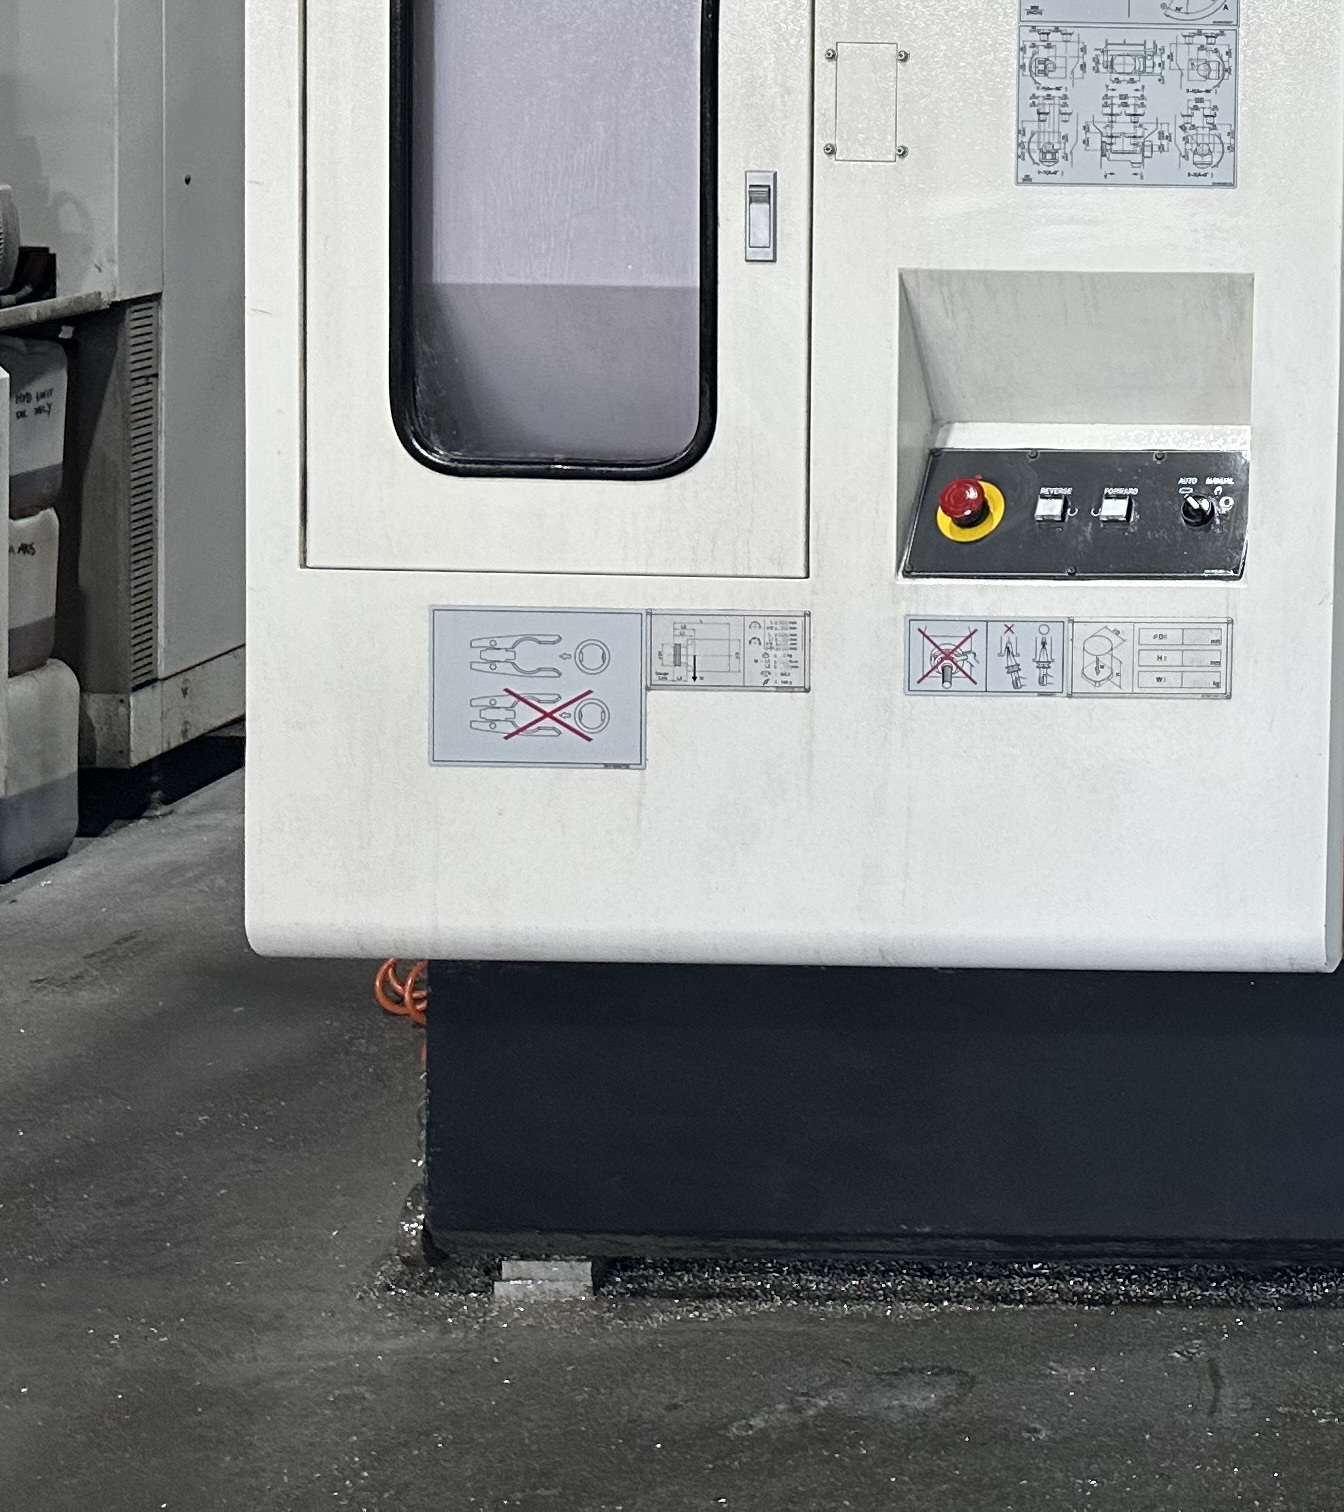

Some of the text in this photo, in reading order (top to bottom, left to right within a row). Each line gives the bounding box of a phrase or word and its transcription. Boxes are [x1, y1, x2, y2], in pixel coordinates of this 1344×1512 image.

[1178, 477, 1198, 485] AUTO
[1205, 477, 1235, 485] MANUAL
[1040, 487, 1072, 495] REVERSE
